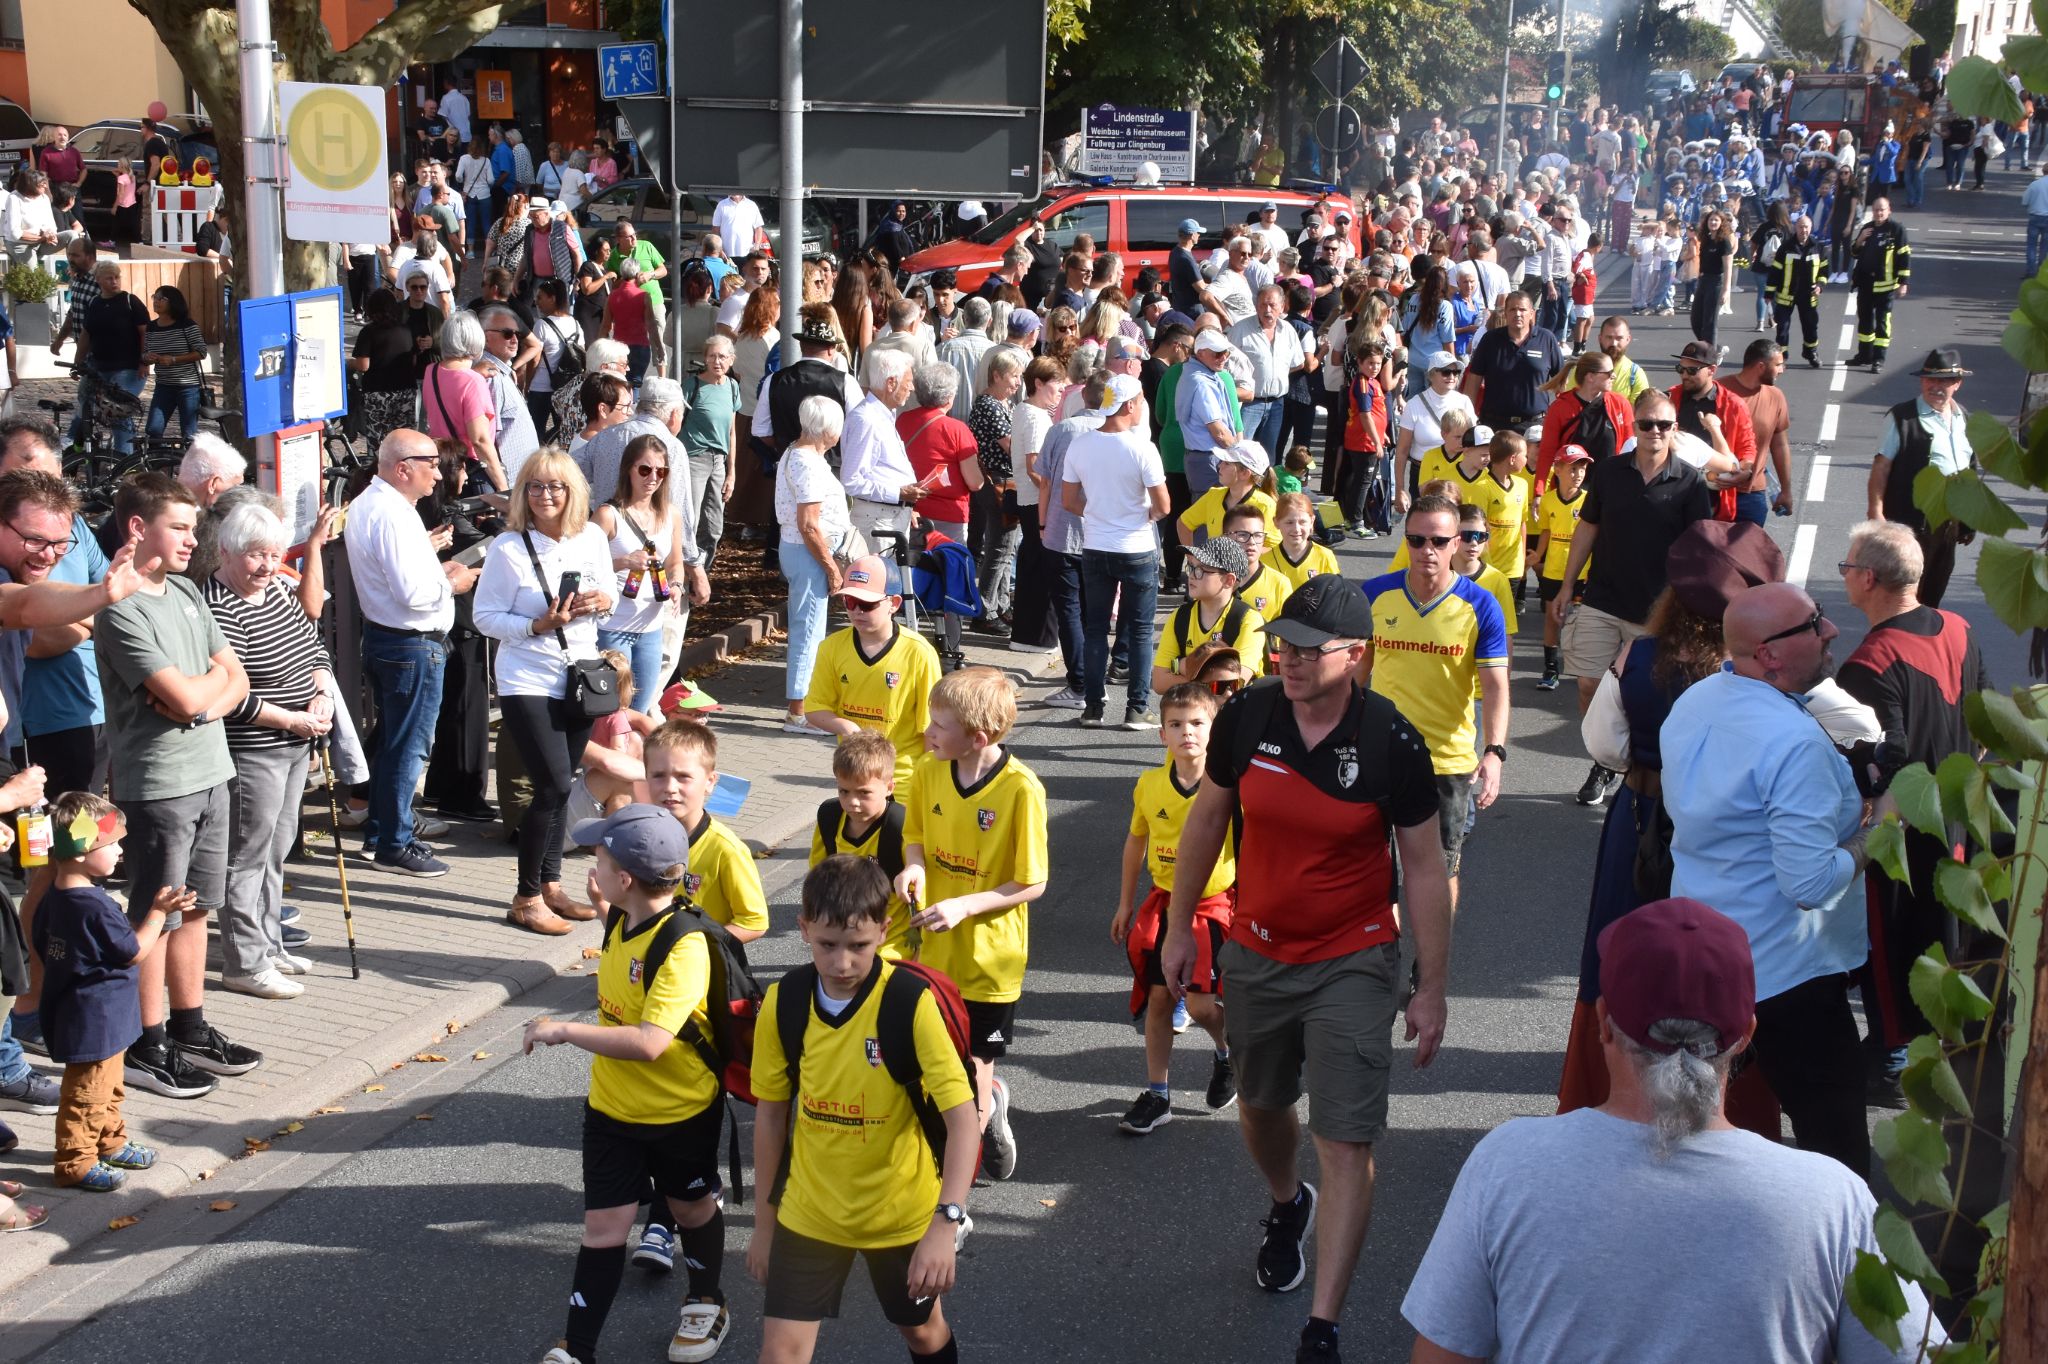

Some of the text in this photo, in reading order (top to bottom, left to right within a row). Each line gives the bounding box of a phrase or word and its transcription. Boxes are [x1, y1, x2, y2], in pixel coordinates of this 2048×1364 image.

[1113, 112, 1165, 123] Lindenstraße
[1090, 127, 1186, 137] Weinbau- & Heimatmuseum
[314, 111, 353, 168] H
[1090, 140, 1115, 150] Fußweg
[1128, 141, 1166, 150] Clingenburg
[1374, 634, 1465, 656] Hemmelrath
[842, 703, 883, 715] HARTIG
[979, 810, 994, 820] TuS
[936, 847, 976, 867] HARTIG
[1250, 920, 1272, 942] M.B.
[866, 1040, 880, 1051] Tu
[872, 1050, 878, 1058] R
[803, 1091, 861, 1115] HARTIG
